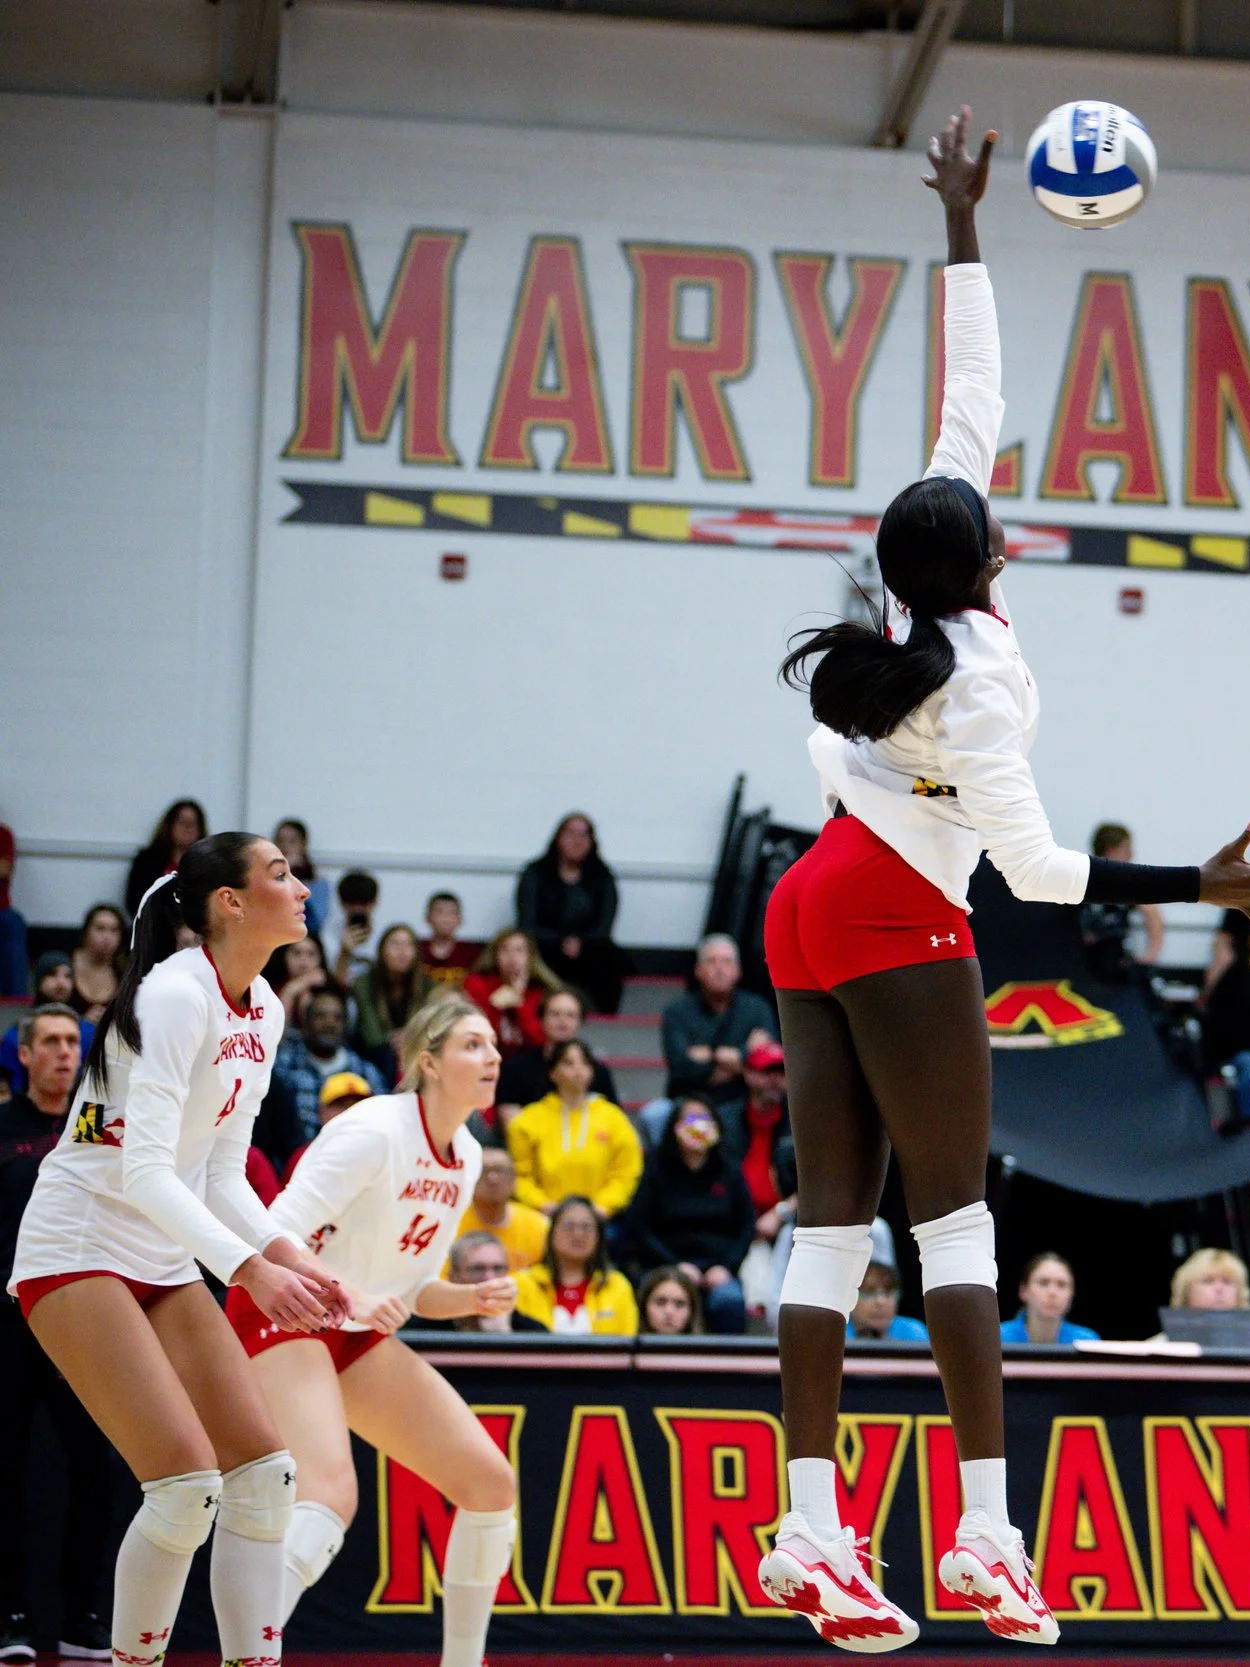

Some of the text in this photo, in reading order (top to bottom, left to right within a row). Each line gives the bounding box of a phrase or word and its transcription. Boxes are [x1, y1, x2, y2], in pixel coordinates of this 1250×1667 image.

[1079, 202, 1099, 216] M
[215, 1079, 242, 1126] 4
[399, 1214, 439, 1255] 44
